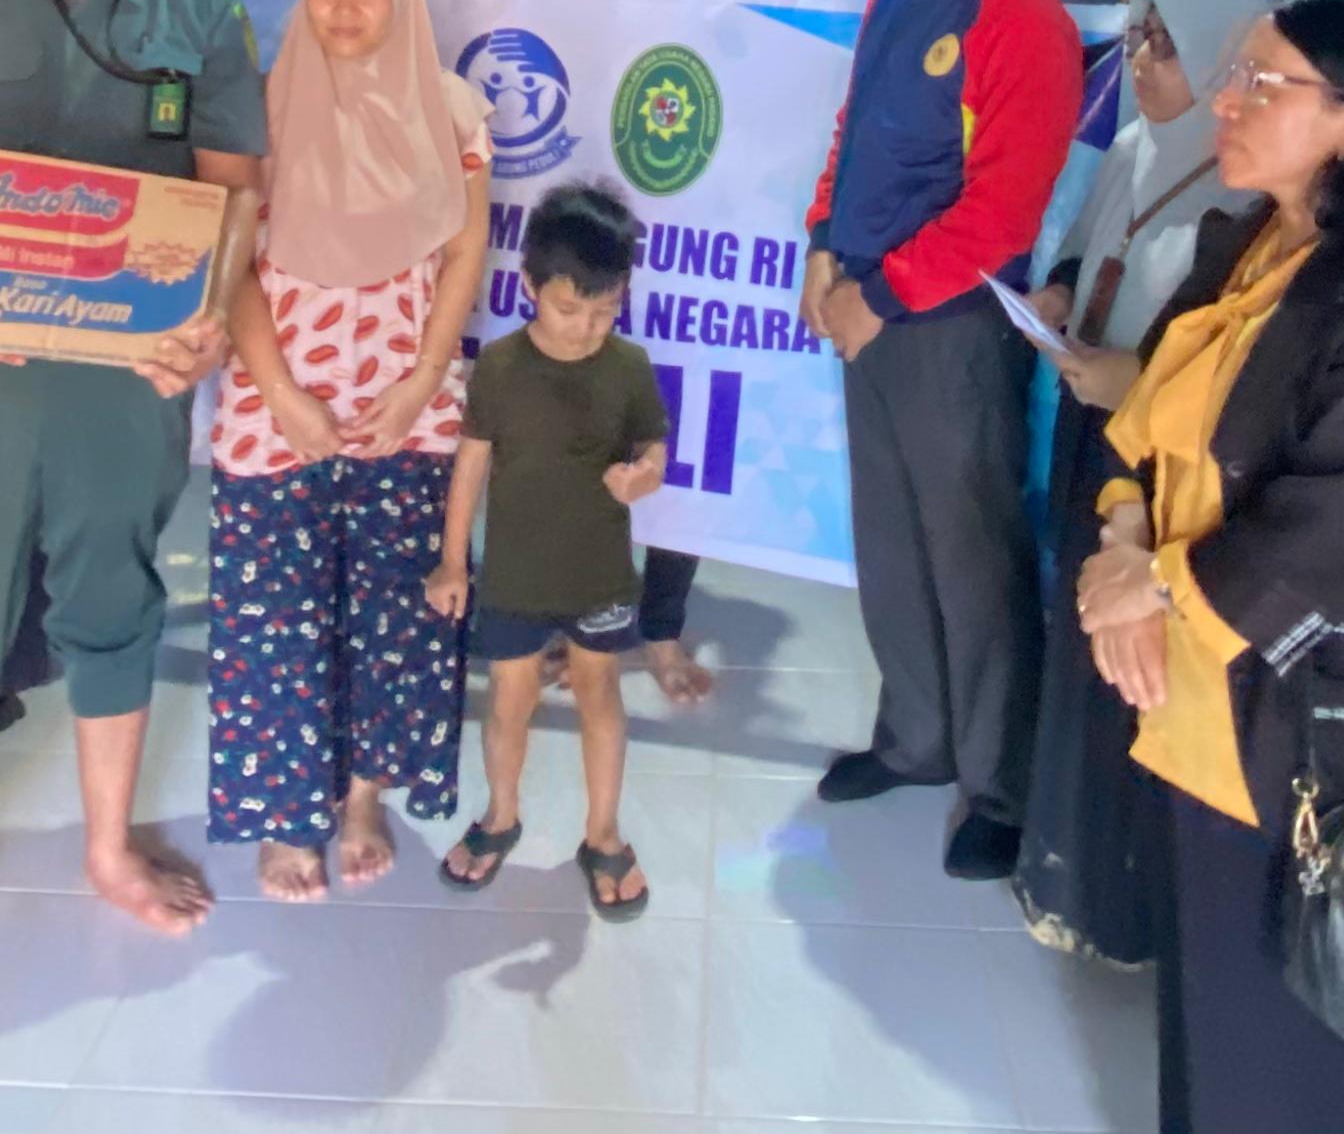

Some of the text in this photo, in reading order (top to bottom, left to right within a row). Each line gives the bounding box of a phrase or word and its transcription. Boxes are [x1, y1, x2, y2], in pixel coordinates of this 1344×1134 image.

[750, 236, 797, 289] RI
[54, 294, 133, 325] Ayam
[644, 291, 821, 354] NEGARA
